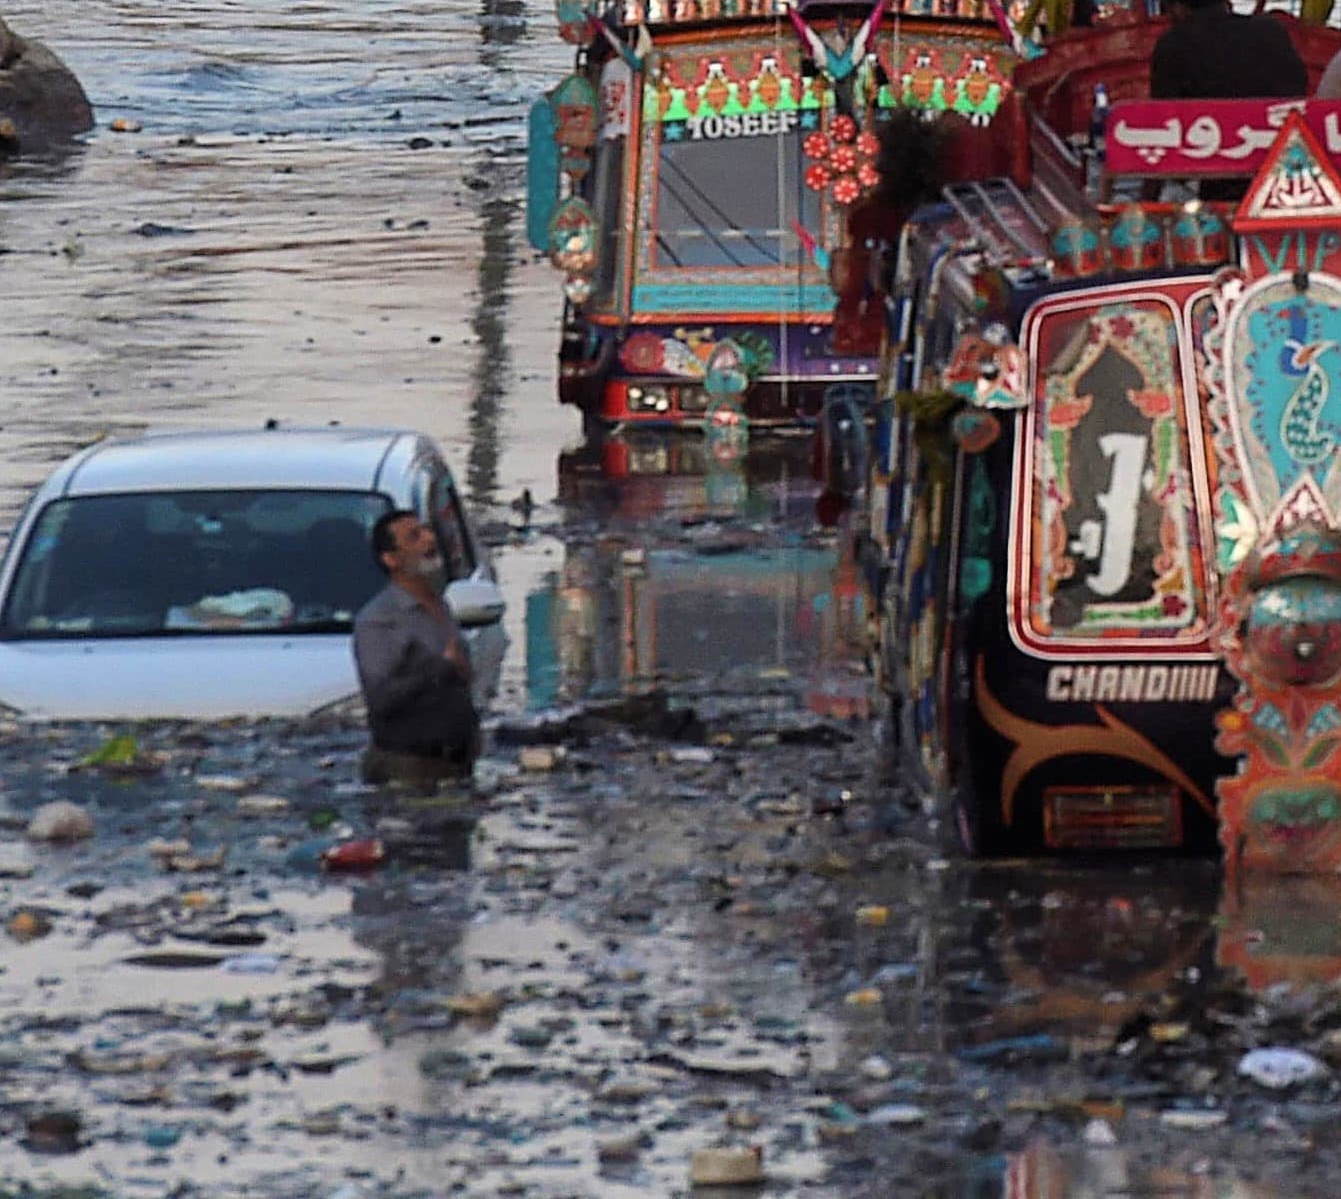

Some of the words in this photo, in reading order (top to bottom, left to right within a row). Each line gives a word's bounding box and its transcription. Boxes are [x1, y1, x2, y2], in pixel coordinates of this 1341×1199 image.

[687, 110, 798, 140] TOSEEF
[1113, 101, 1306, 165] گروپ
[1252, 231, 1341, 275] VIP
